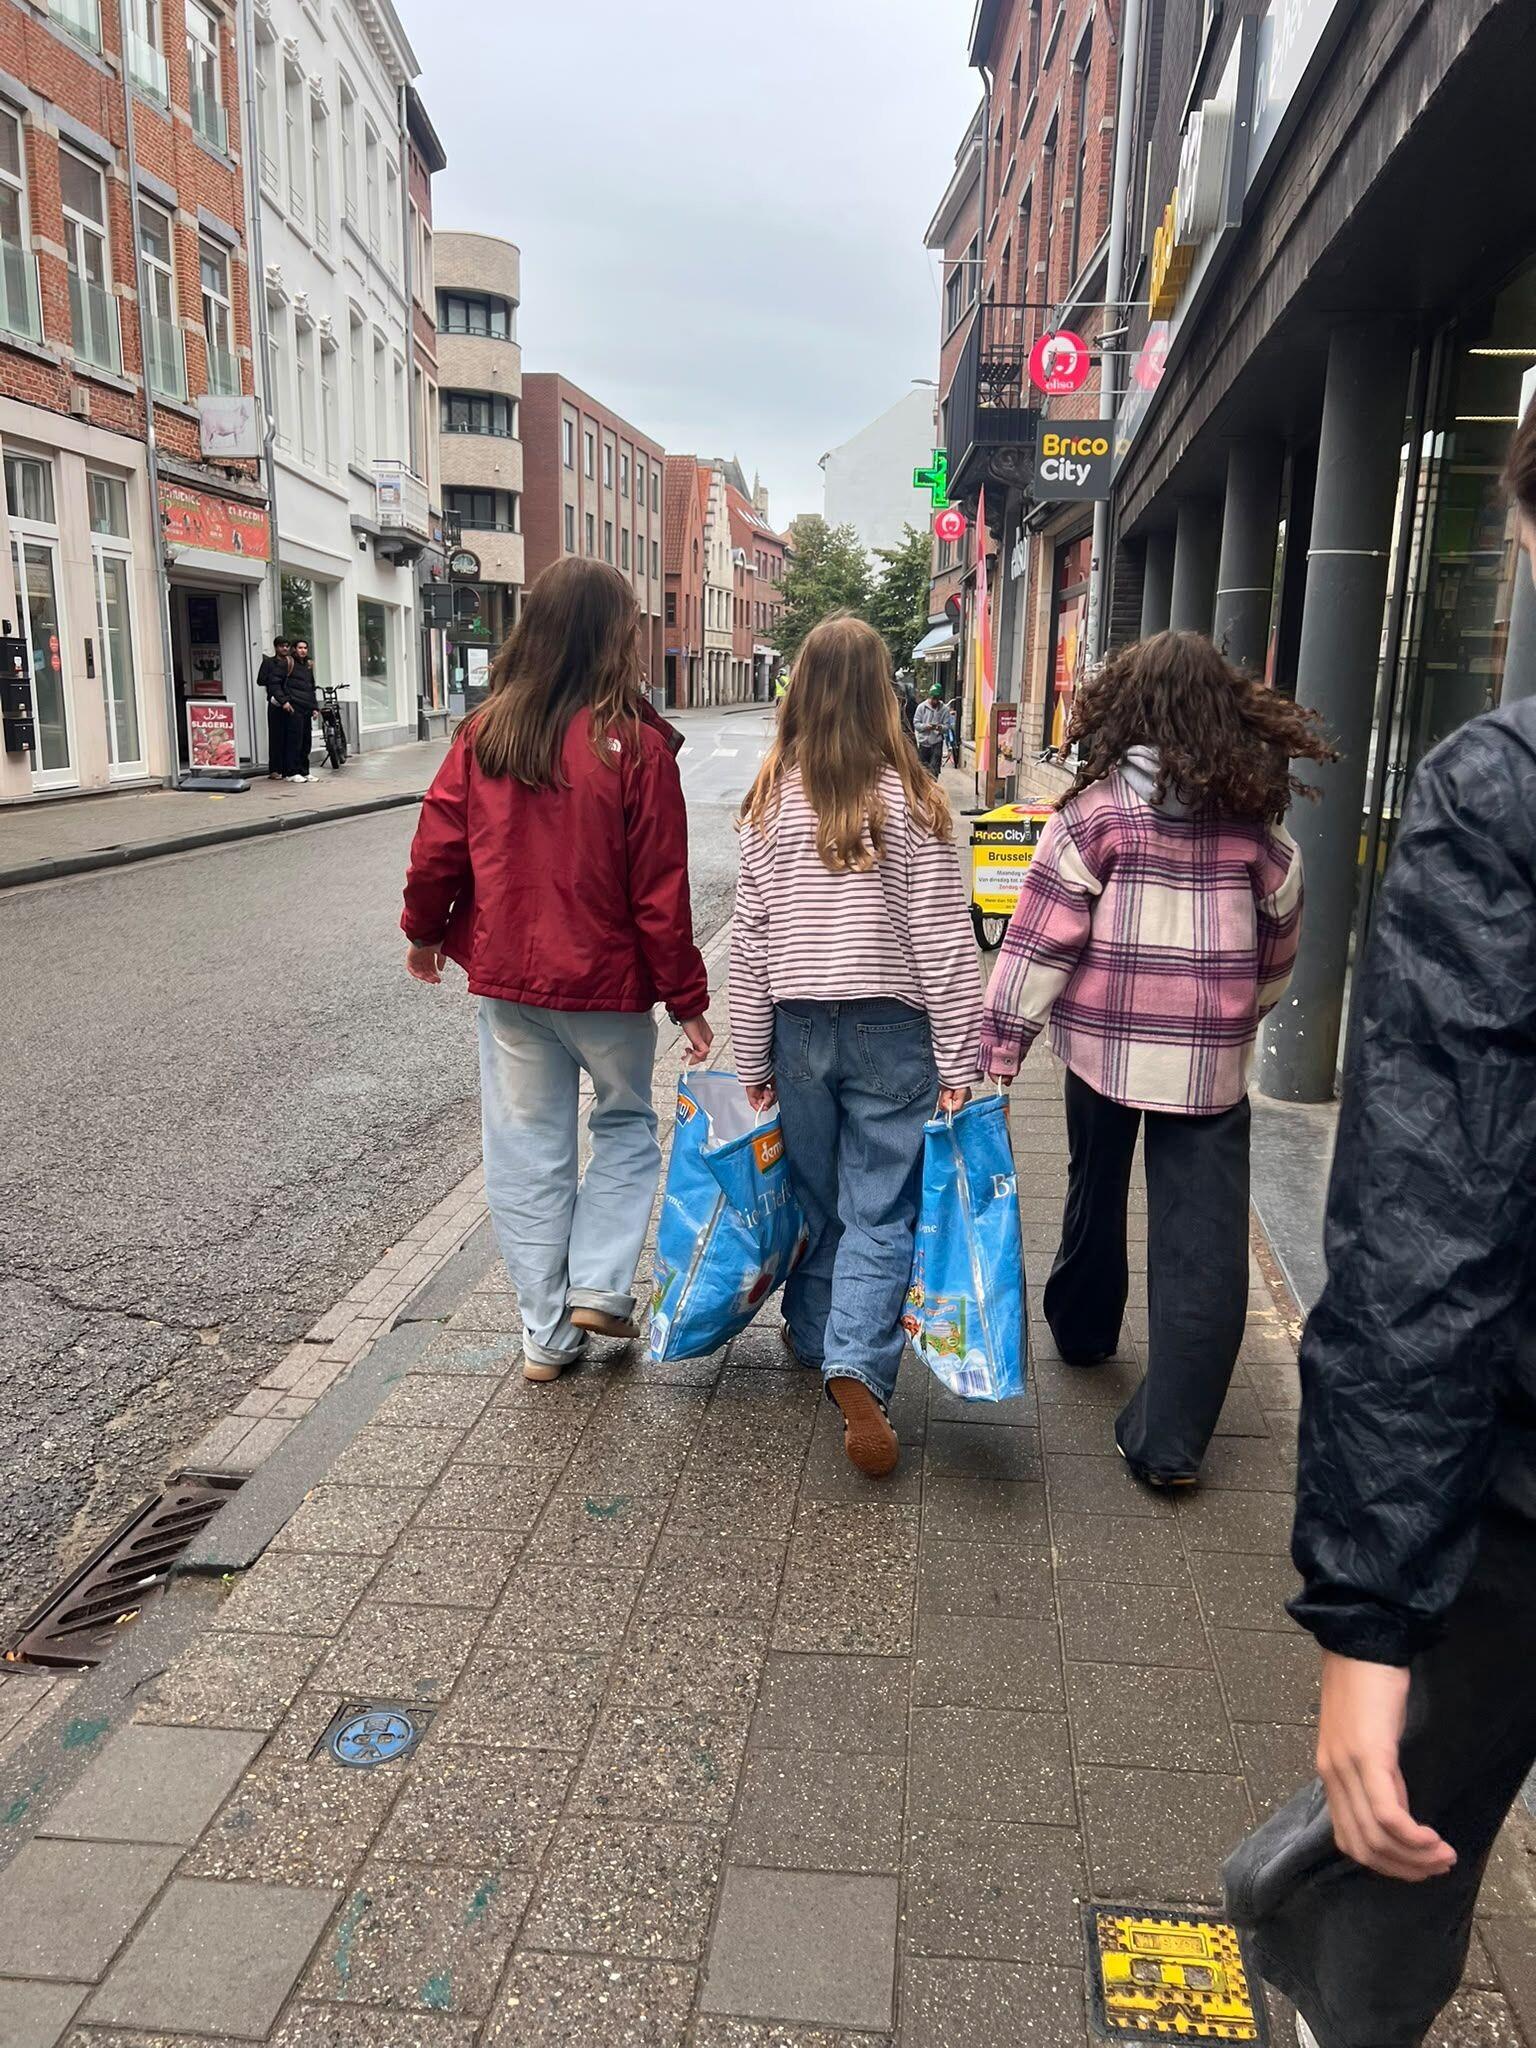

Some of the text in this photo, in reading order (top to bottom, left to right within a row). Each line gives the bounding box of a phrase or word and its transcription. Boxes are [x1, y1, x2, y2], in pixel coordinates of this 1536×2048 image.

[1045, 379, 1074, 390] elisa
[1042, 433, 1108, 456] Brico
[1040, 457, 1092, 486] City
[191, 720, 234, 730] SLAGERIJ
[989, 1171, 1018, 1199] Bi
